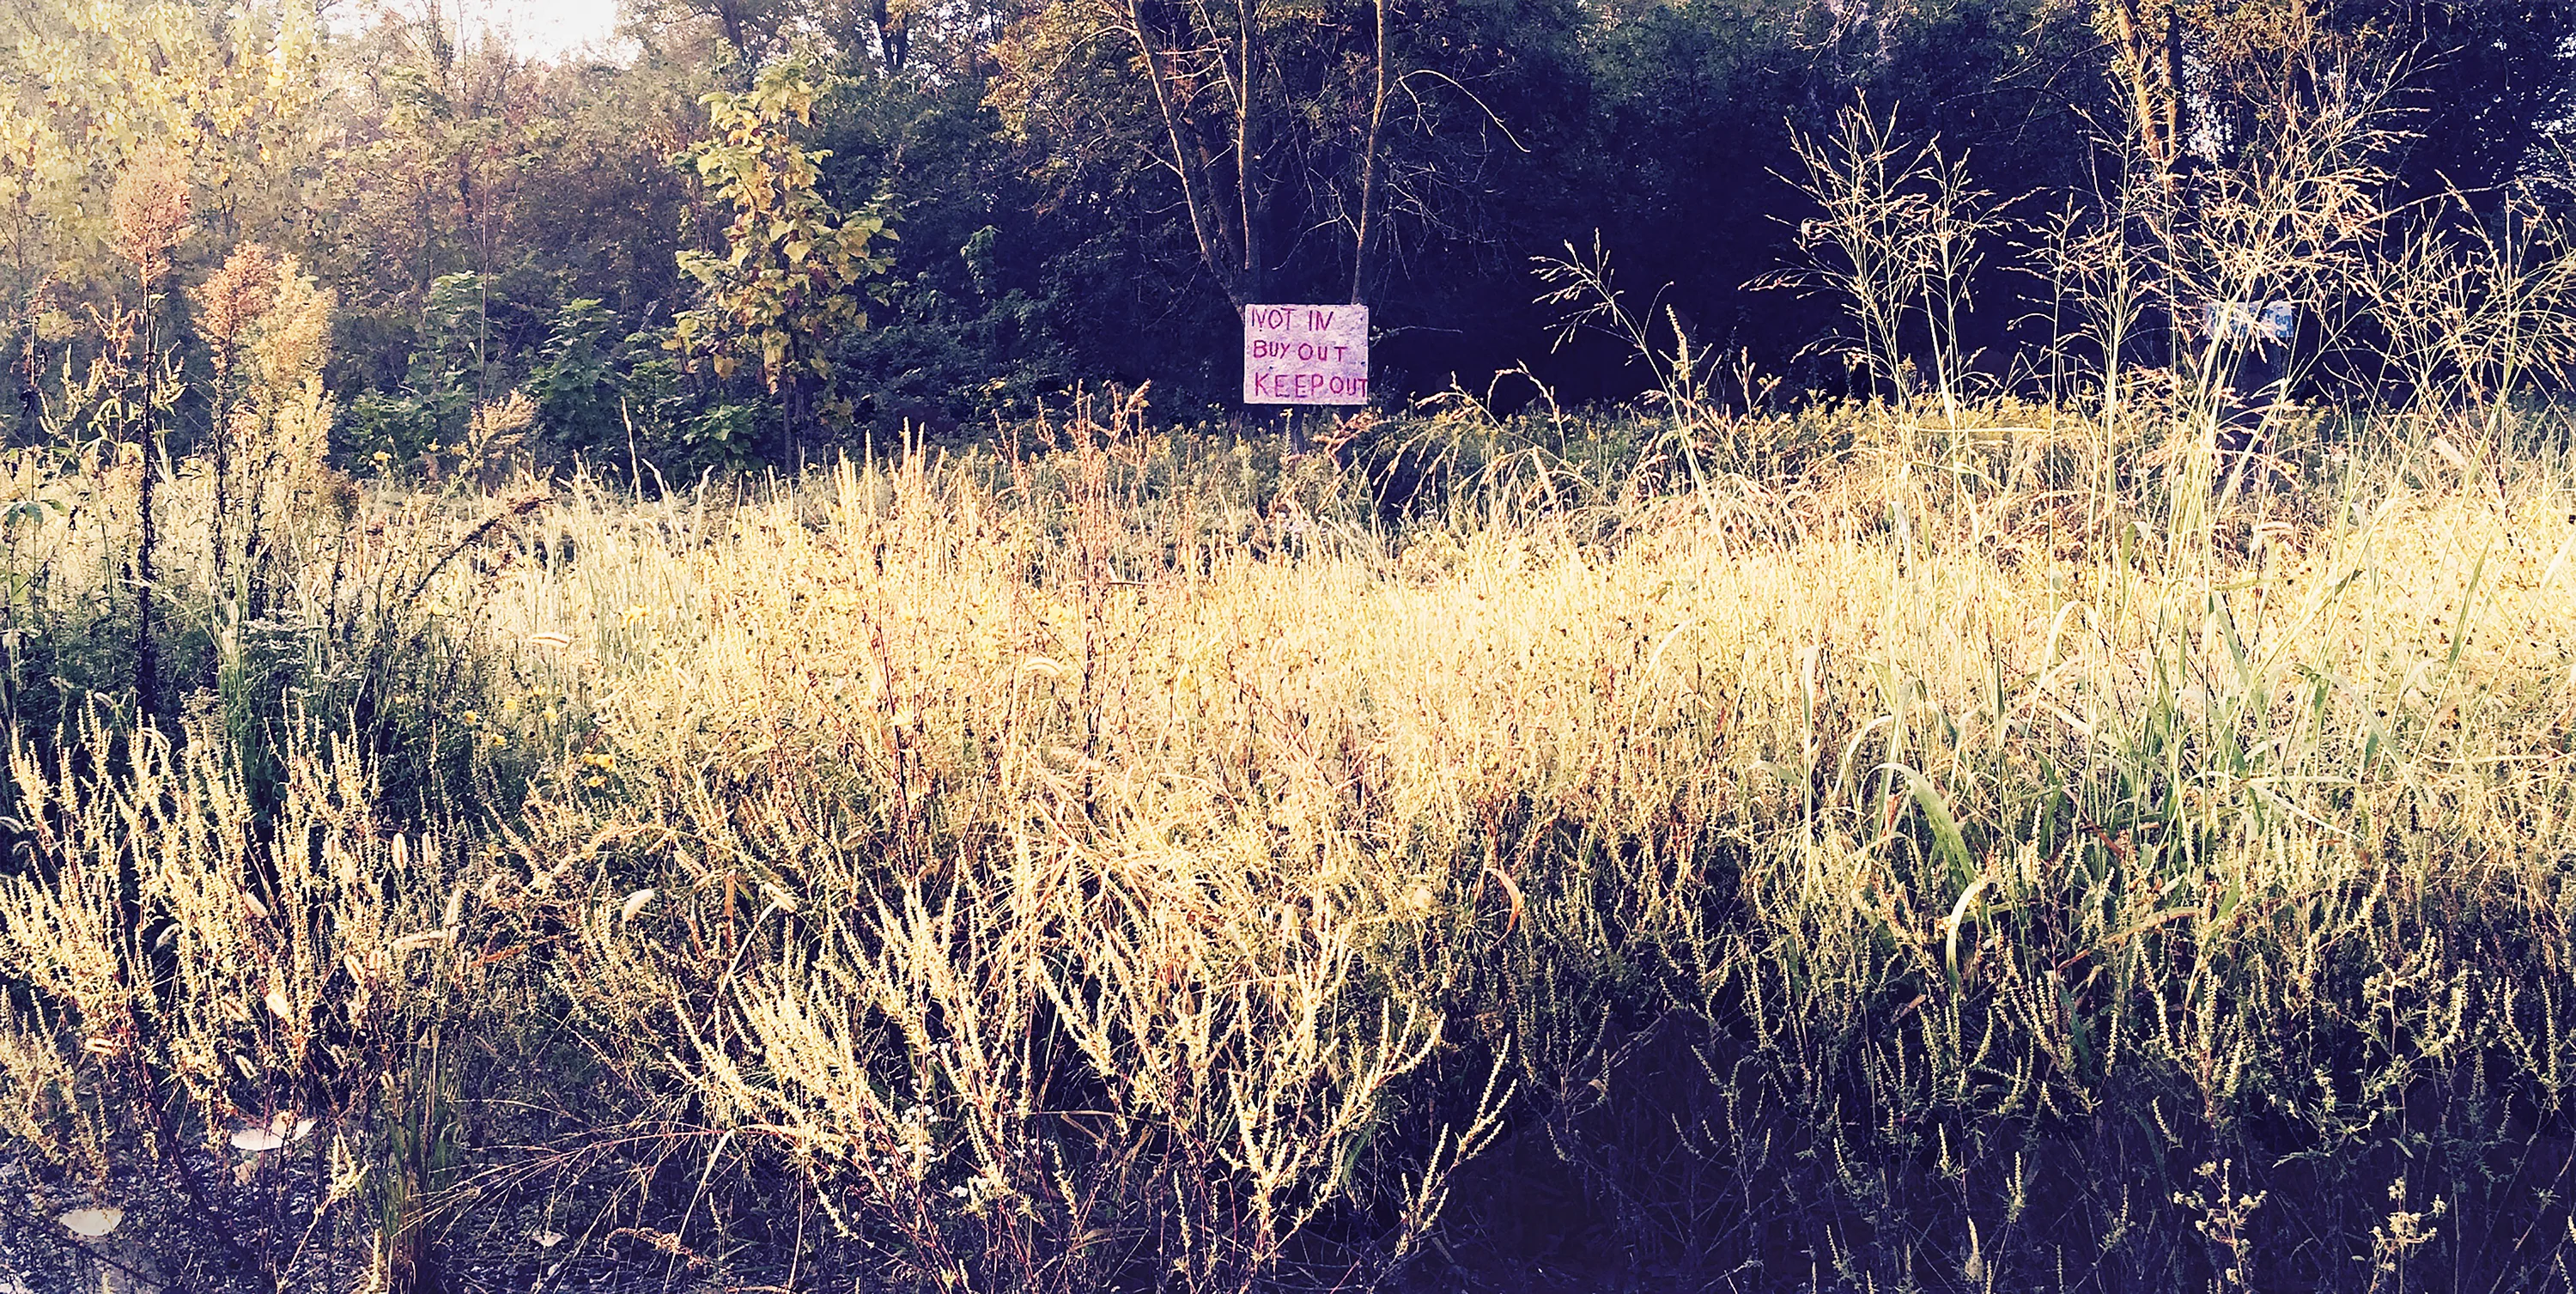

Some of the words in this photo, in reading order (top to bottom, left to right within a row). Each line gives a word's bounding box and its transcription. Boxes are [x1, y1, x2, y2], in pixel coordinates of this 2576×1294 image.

[1252, 307, 1296, 331] NOT
[1309, 310, 1334, 331] IN
[1253, 339, 1290, 359] BUY
[1297, 343, 1347, 361] OUT
[1255, 372, 1324, 398] KEEP
[1329, 376, 1368, 398] OUT
